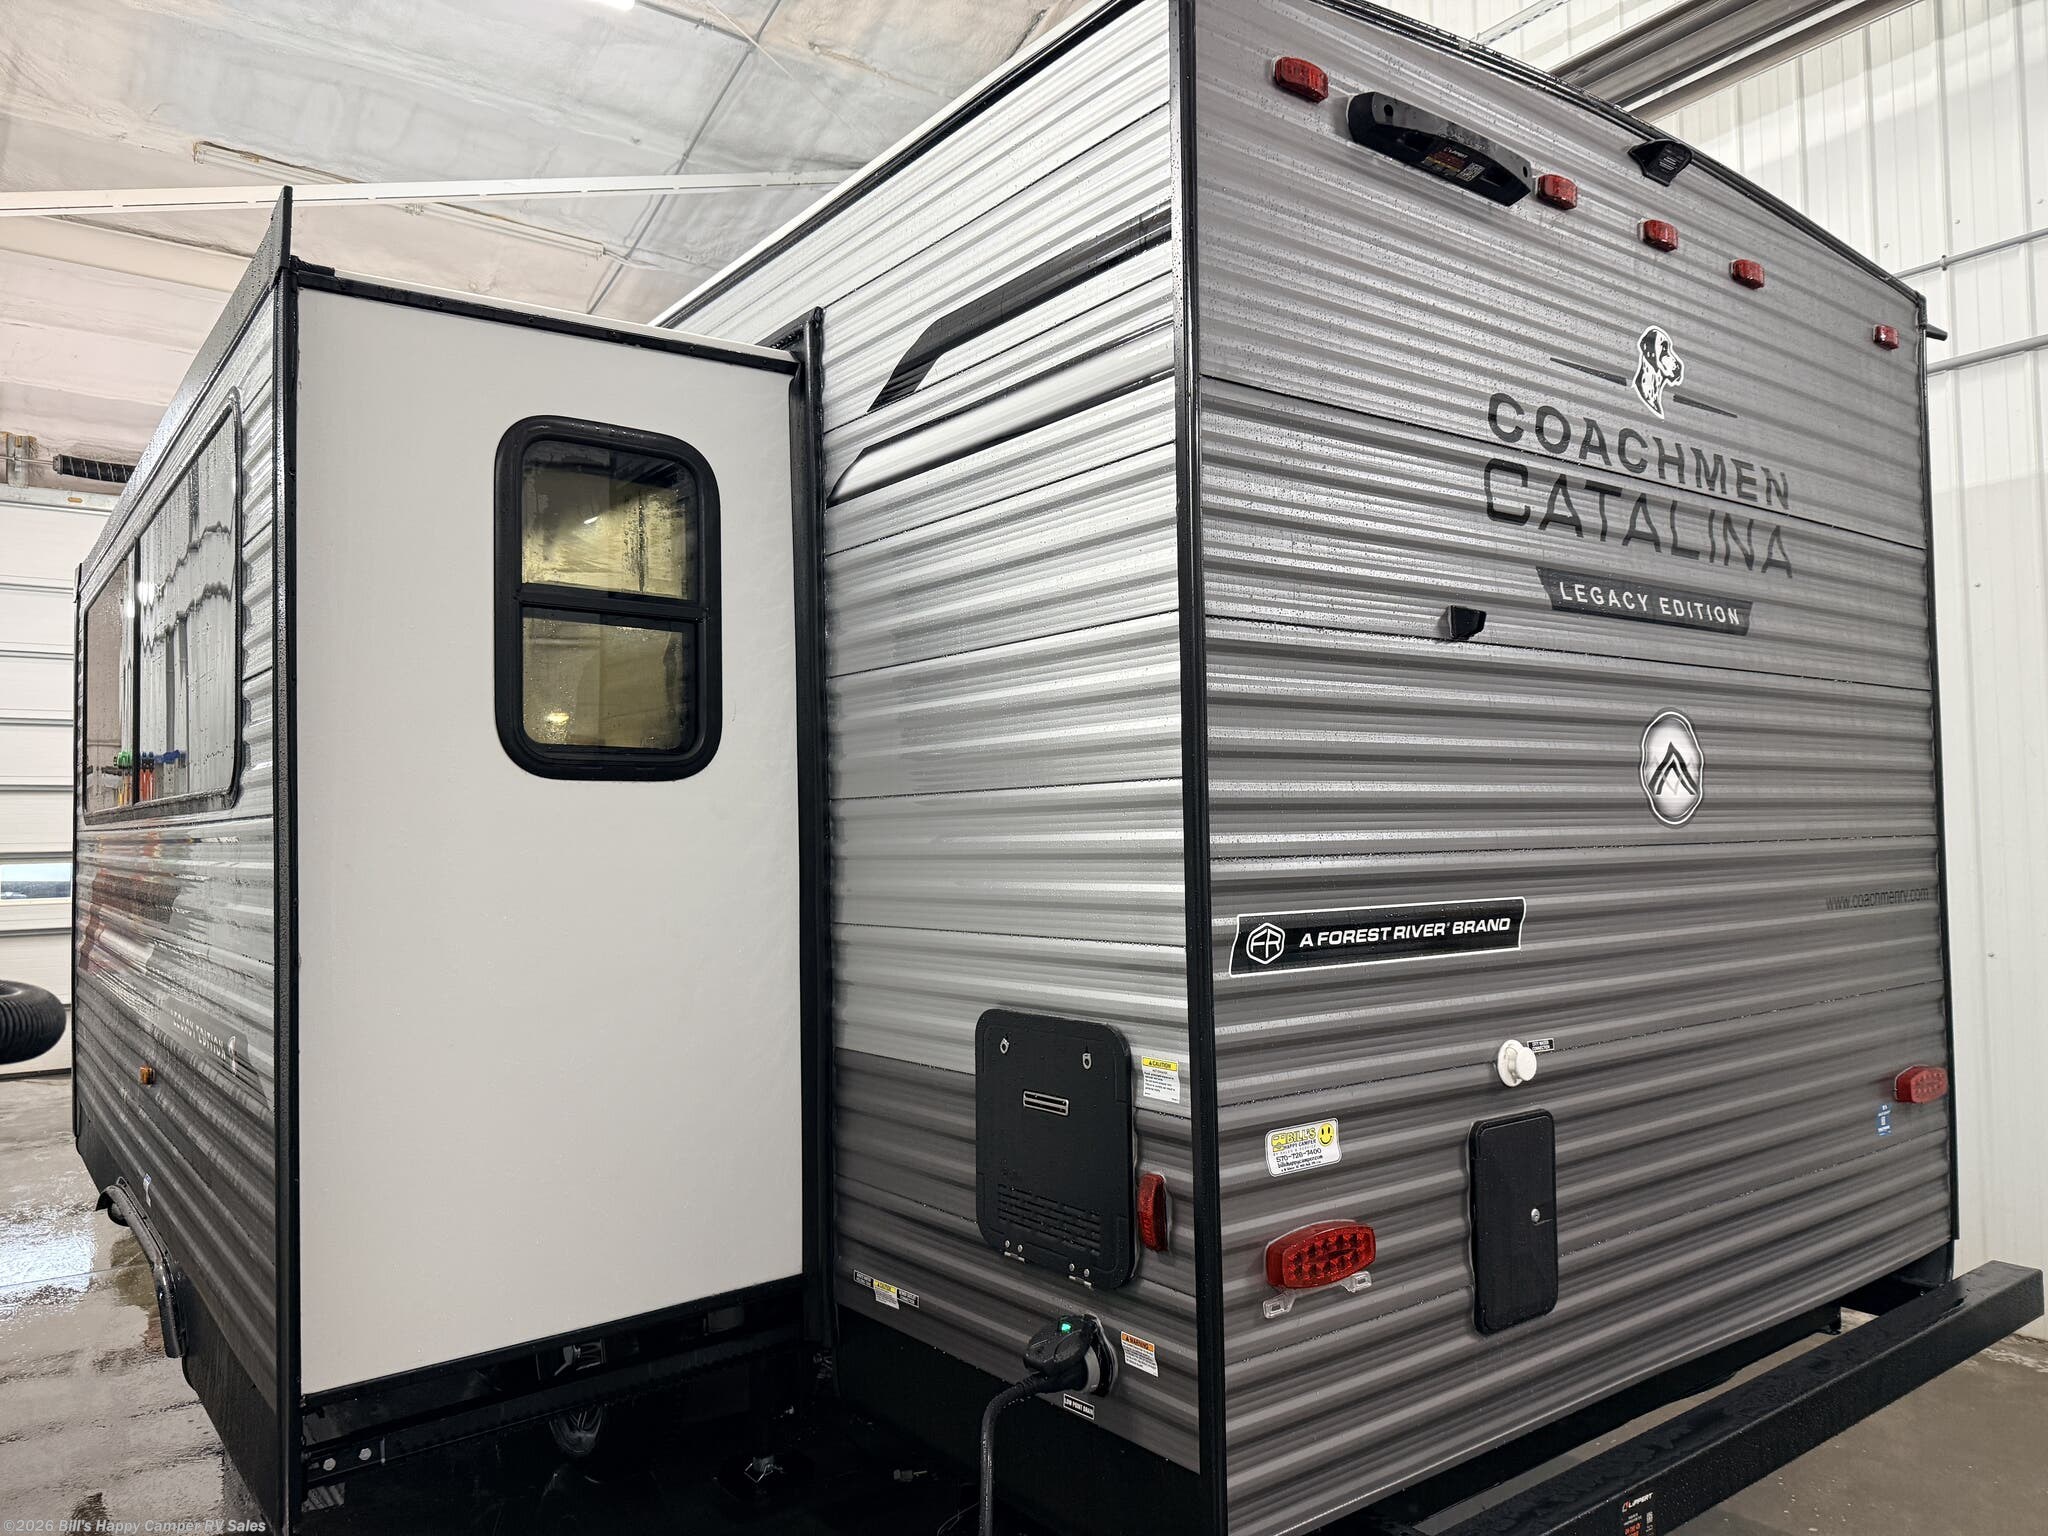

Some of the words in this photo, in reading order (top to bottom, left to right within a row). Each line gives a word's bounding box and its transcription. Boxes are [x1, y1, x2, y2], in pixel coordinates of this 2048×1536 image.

[1486, 391, 1790, 510] COACHMEN
[1483, 458, 1793, 579] CATALINA
[1559, 581, 1649, 612] LEGACY
[1660, 597, 1740, 626] EDITION
[1299, 932, 1314, 948] A
[1316, 926, 1393, 946] FOREST
[1452, 917, 1511, 936] BRAND
[1152, 1060, 1172, 1069] CAUTION
[1286, 1127, 1317, 1144] BILL'S
[1072, 1400, 1083, 1412] POINT
